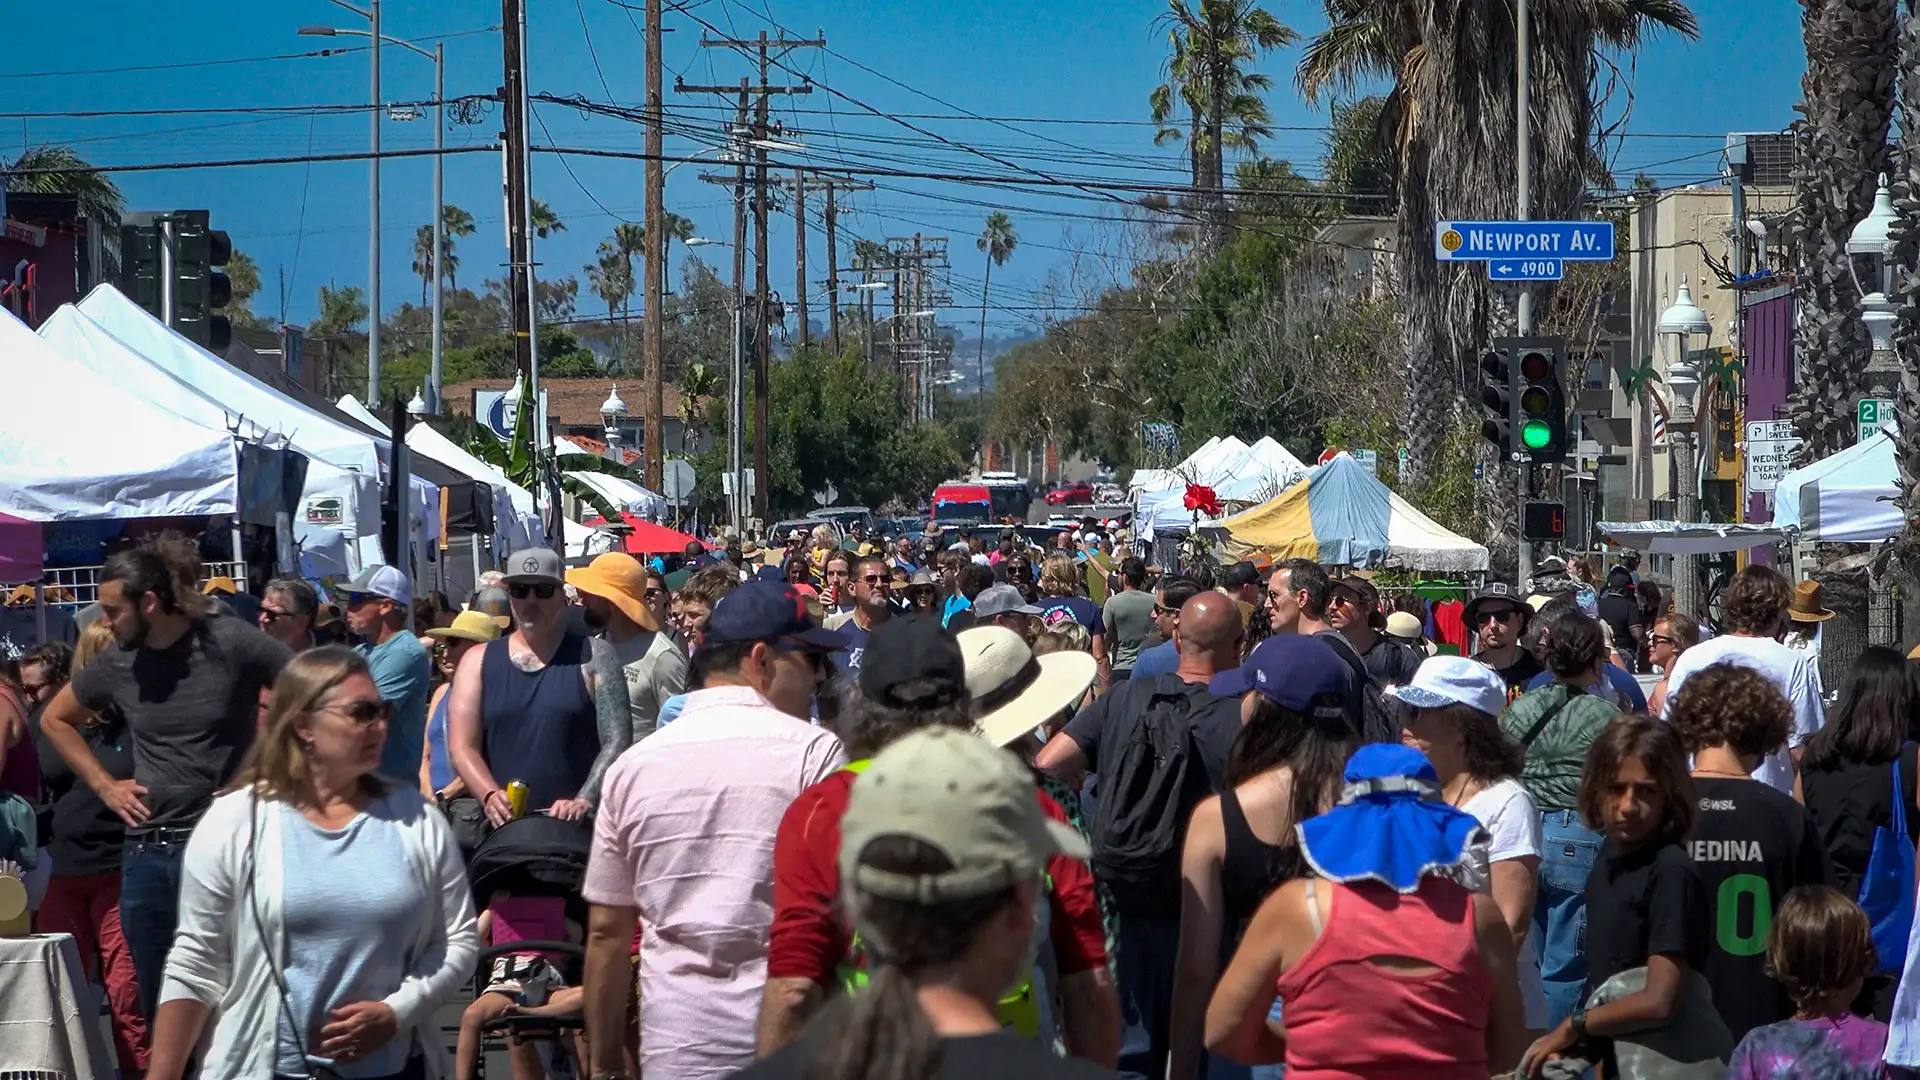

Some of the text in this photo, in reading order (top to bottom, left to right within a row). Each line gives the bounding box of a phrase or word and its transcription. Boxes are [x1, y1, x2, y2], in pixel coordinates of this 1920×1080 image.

[1470, 230, 1560, 251] NEWPORT
[1521, 262, 1555, 276] 4900
[1863, 404, 1893, 420] 2 HO
[1711, 800, 1736, 811] WSL
